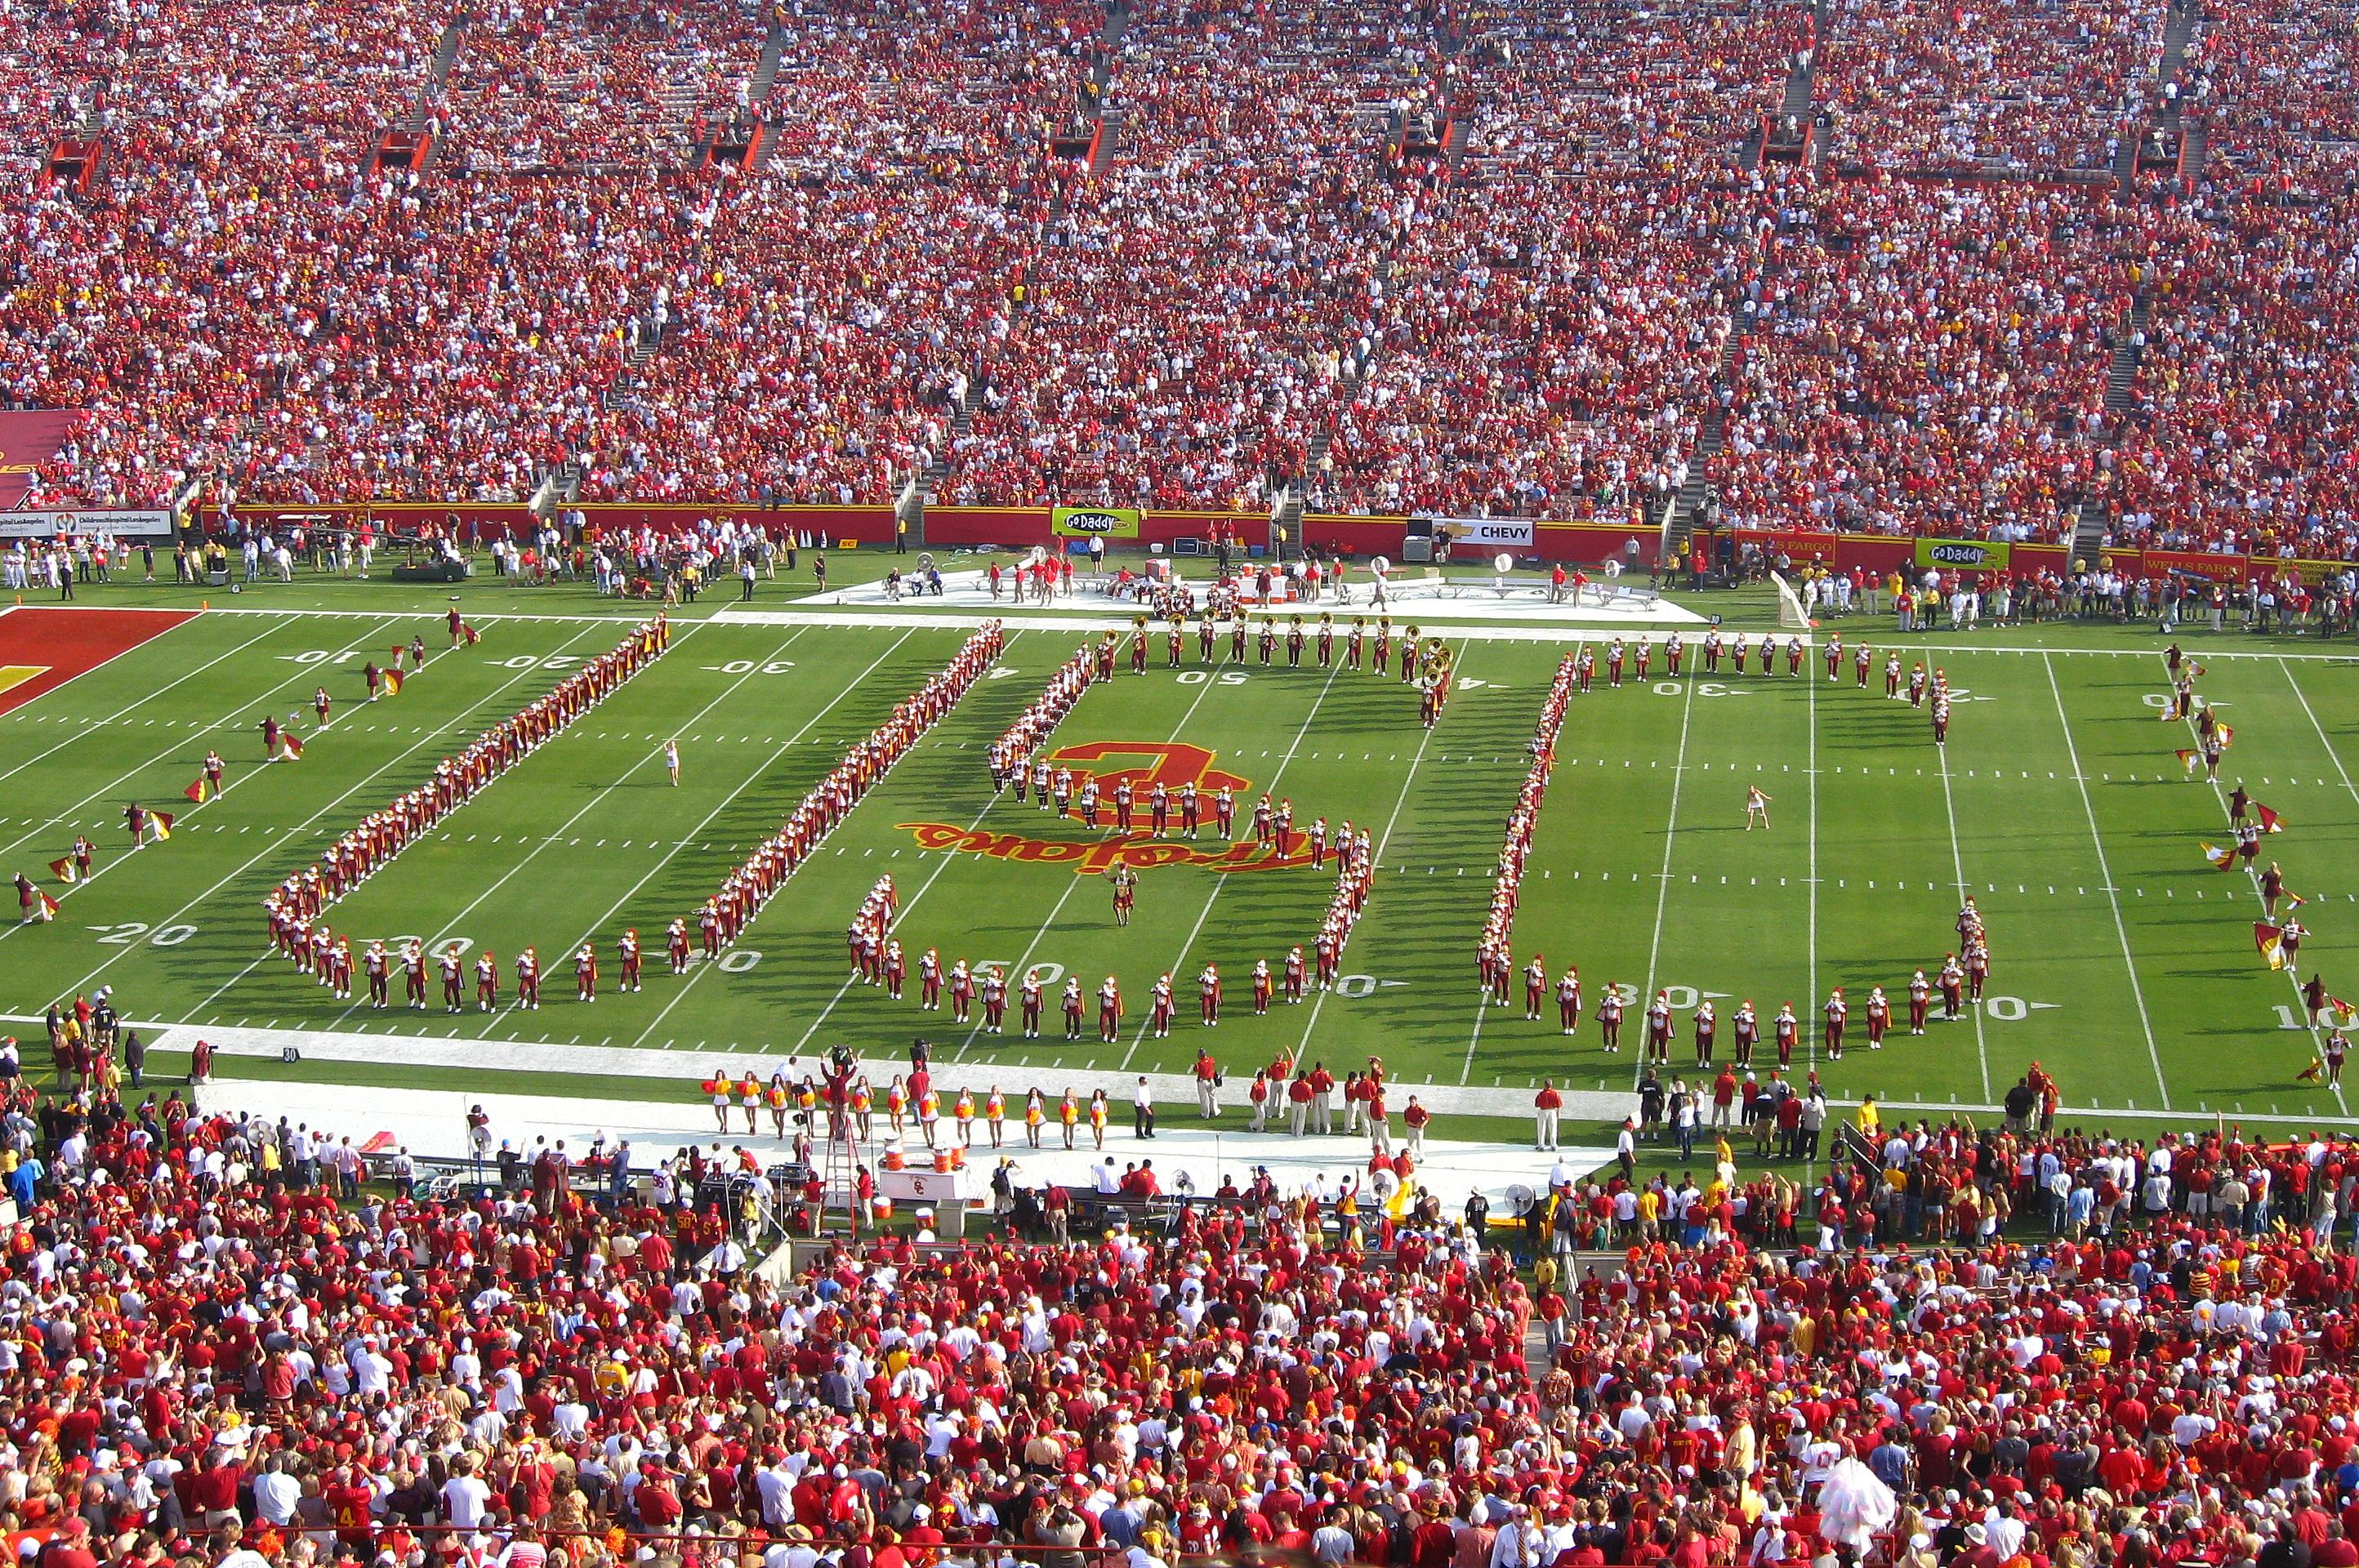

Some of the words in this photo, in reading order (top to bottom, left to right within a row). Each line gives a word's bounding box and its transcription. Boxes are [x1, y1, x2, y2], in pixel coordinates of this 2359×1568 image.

[1481, 526, 1529, 539] CHEVY
[1787, 541, 1832, 552] FARGO
[295, 650, 361, 666] 10
[502, 655, 582, 670] 20
[720, 659, 796, 675] 30
[1175, 670, 1251, 686] 50
[1652, 681, 1728, 697] 30
[96, 922, 198, 947] 20
[970, 960, 1065, 986] 50
[283, 1048, 297, 1062] 30
[677, 1214, 691, 1230] 58
[340, 1507, 355, 1528] 4
